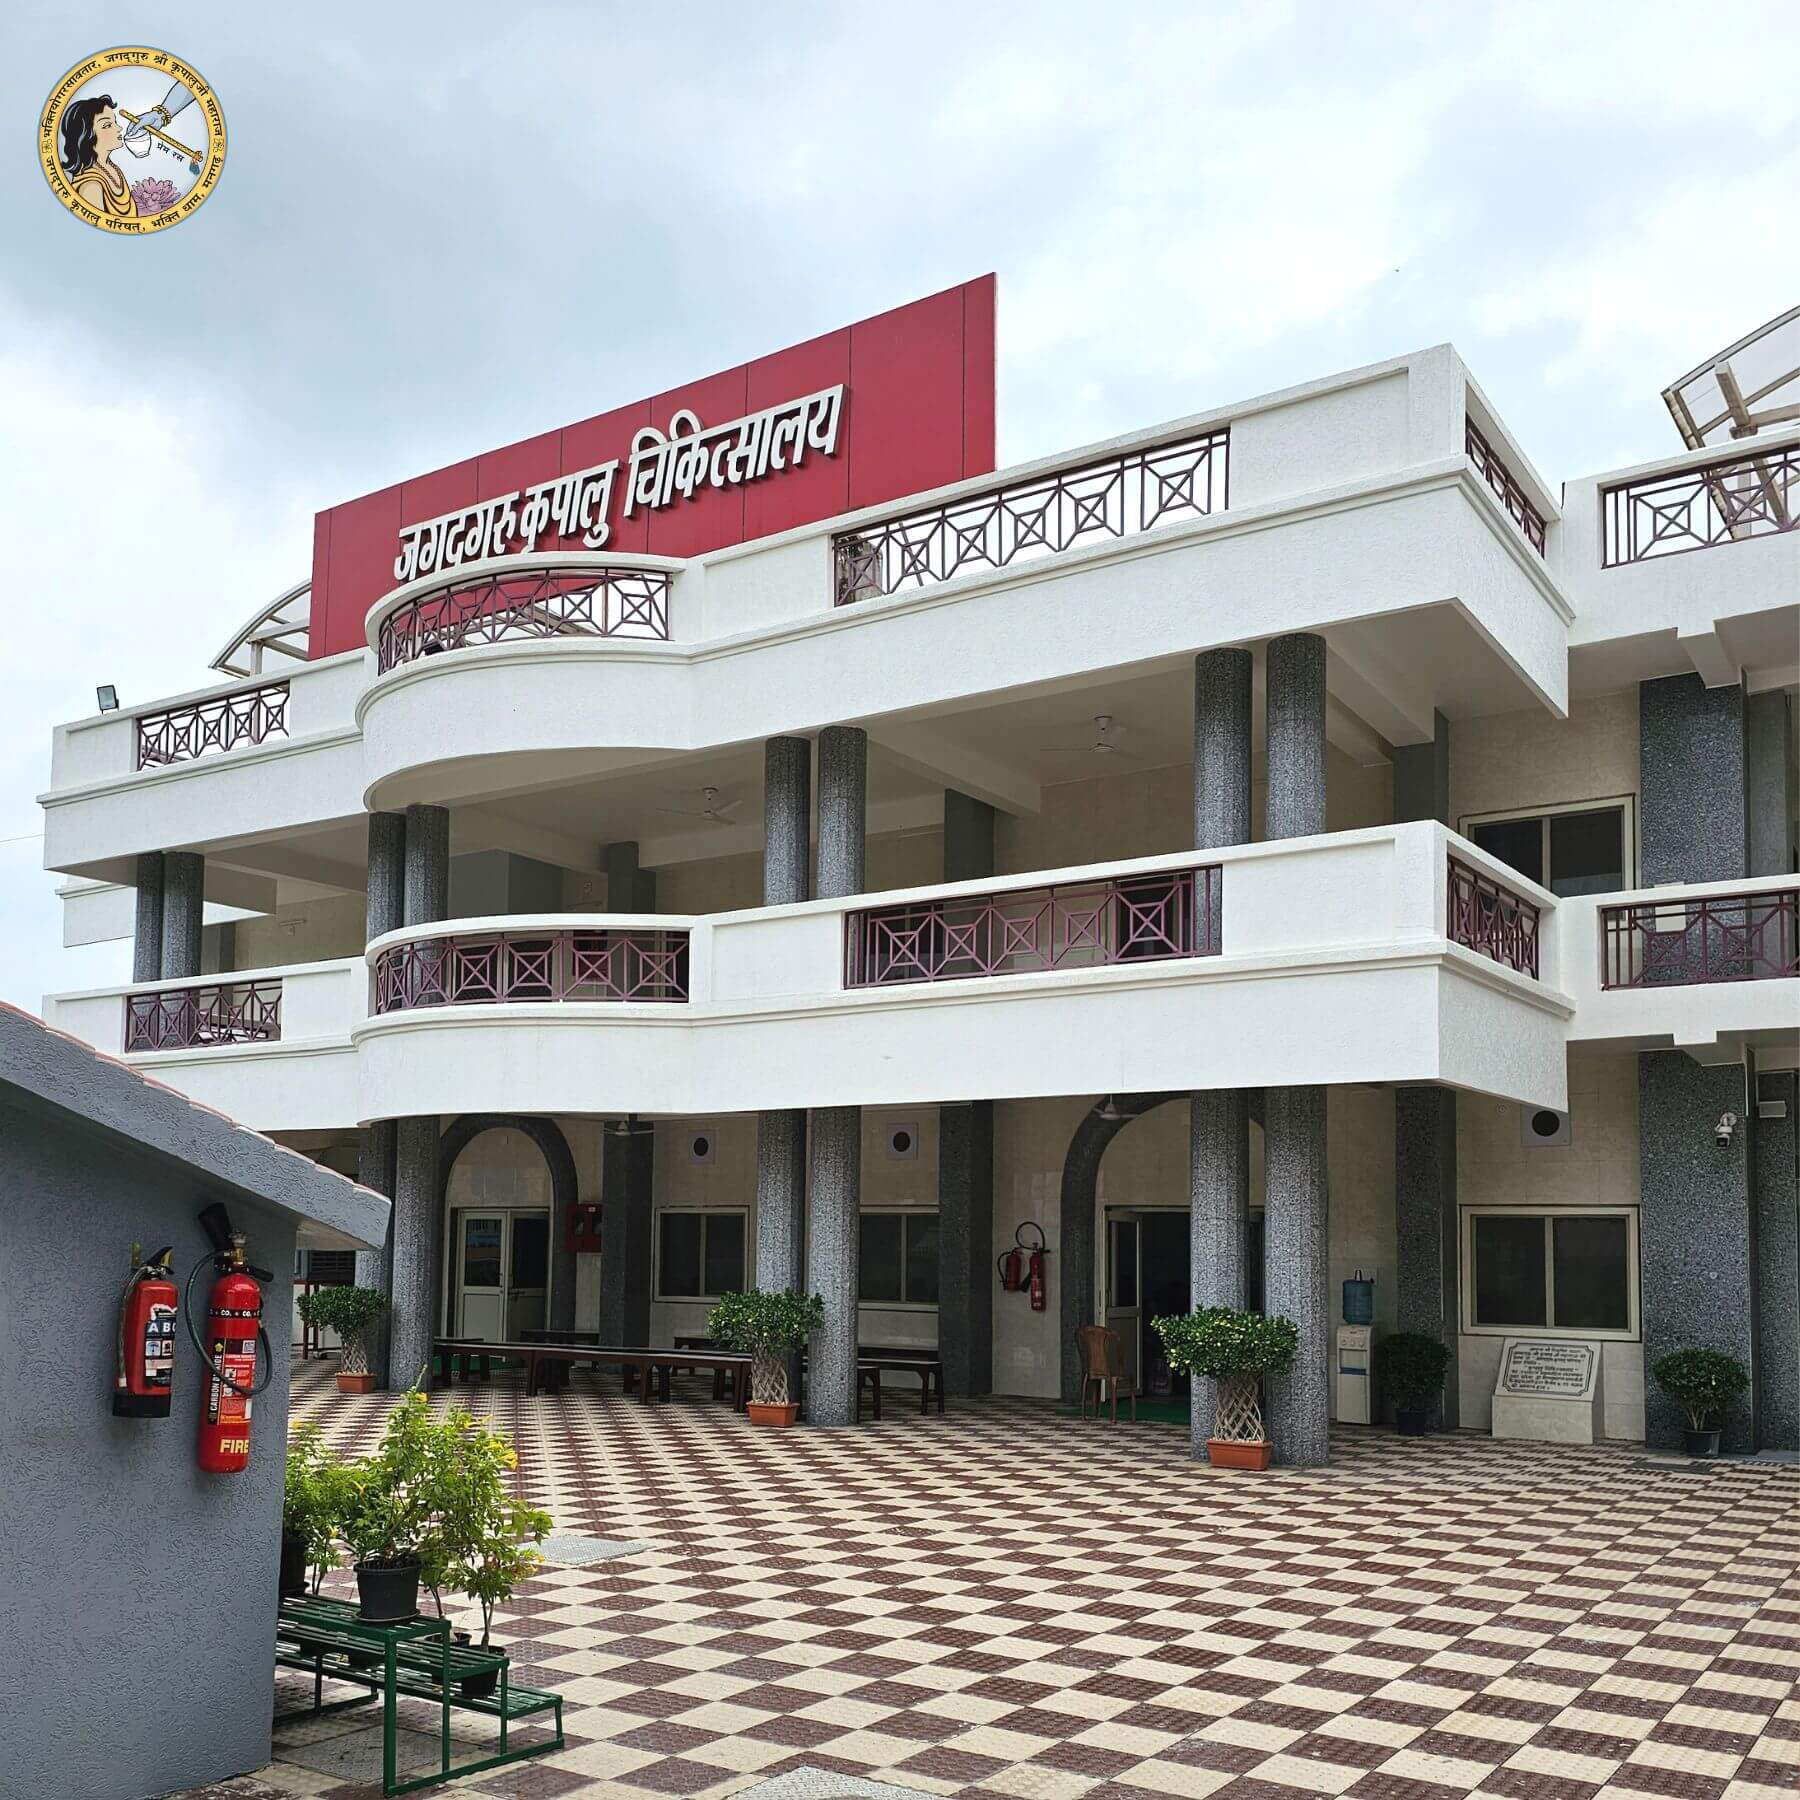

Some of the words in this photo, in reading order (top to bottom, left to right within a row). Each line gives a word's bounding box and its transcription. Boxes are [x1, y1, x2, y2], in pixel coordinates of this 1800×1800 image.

[624, 384, 845, 518] चिकित्सालय
[210, 1382, 220, 1411] CARBON
[220, 1439, 249, 1453] FIRE
